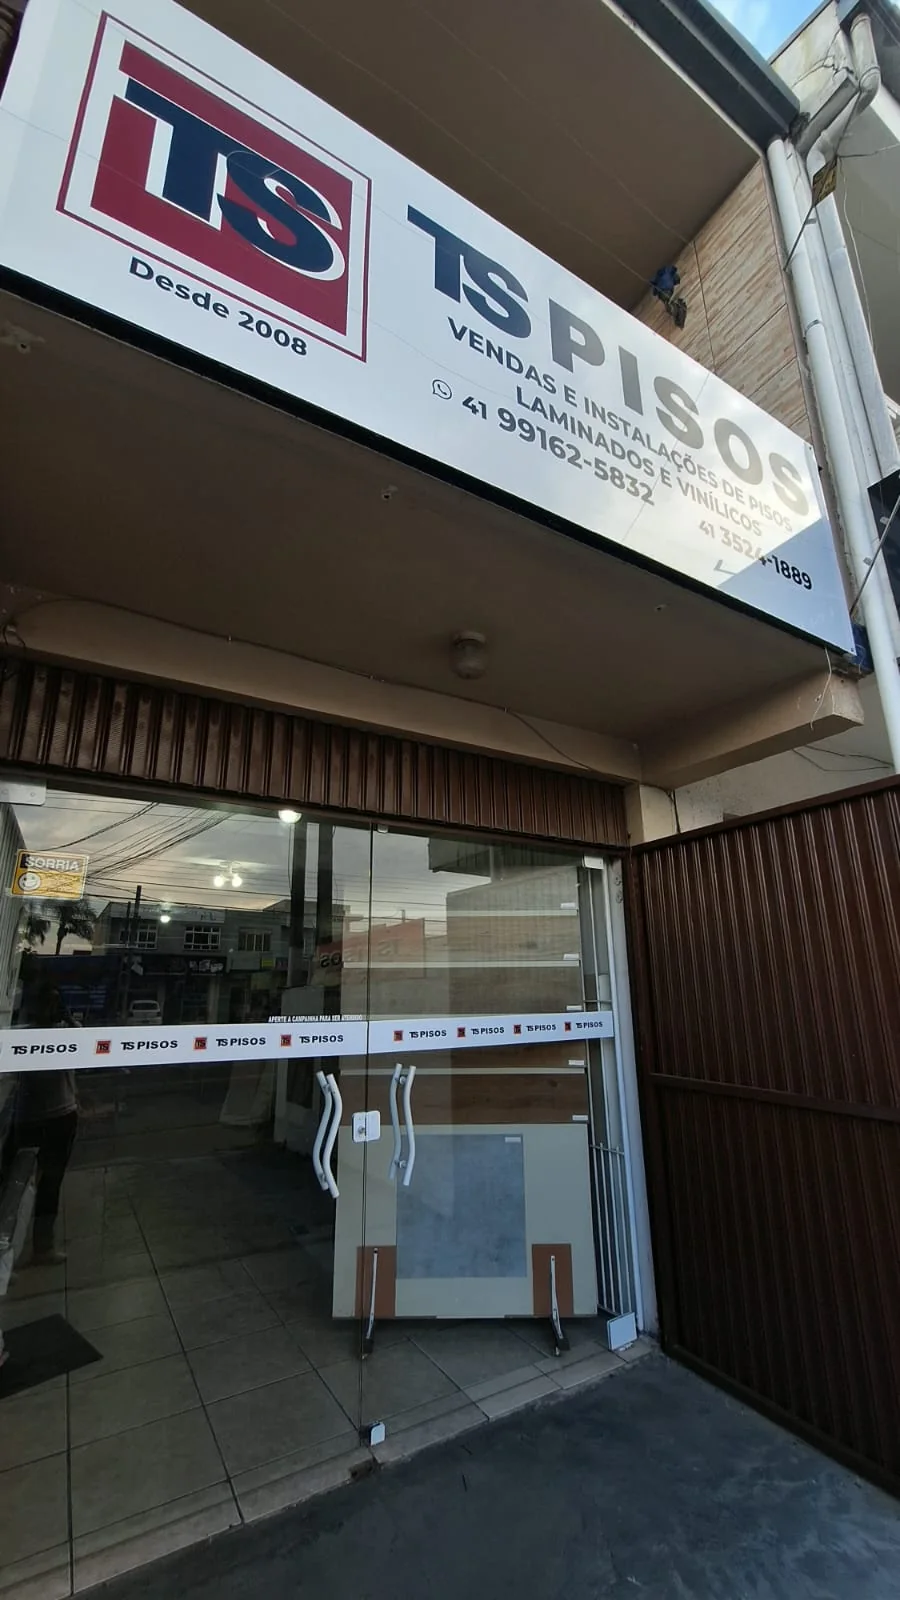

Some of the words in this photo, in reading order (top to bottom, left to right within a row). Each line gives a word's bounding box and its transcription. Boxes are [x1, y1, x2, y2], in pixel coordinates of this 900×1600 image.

[125, 78, 345, 281] TS
[130, 257, 230, 318] Desde
[238, 310, 307, 356] 2008
[408, 204, 531, 338] TS
[549, 298, 809, 517] PISOS
[448, 317, 557, 394] VENDAS
[564, 384, 578, 407] E
[584, 397, 718, 489] INSTALAÇÕES
[723, 480, 745, 505] DE
[750, 498, 793, 532] PISOS
[462, 396, 487, 420] 41
[498, 408, 655, 506] 99162-5832
[516, 386, 655, 478] LAMINADOS
[661, 468, 672, 488] E
[676, 477, 762, 537] VINÍLICOS
[699, 520, 715, 539] 41
[720, 526, 812, 590] 3524-1889
[25, 855, 80, 871] SORRIA
[11, 1045, 28, 1055] TS
[30, 1043, 78, 1055] PISOS
[121, 1041, 135, 1051] TS
[137, 1040, 178, 1050] PISOS
[216, 1038, 228, 1047] TS
[230, 1037, 266, 1046] PISOS
[312, 1034, 344, 1043] PISOS
[420, 1030, 447, 1038] PISOS
[481, 1026, 505, 1034] PISOS
